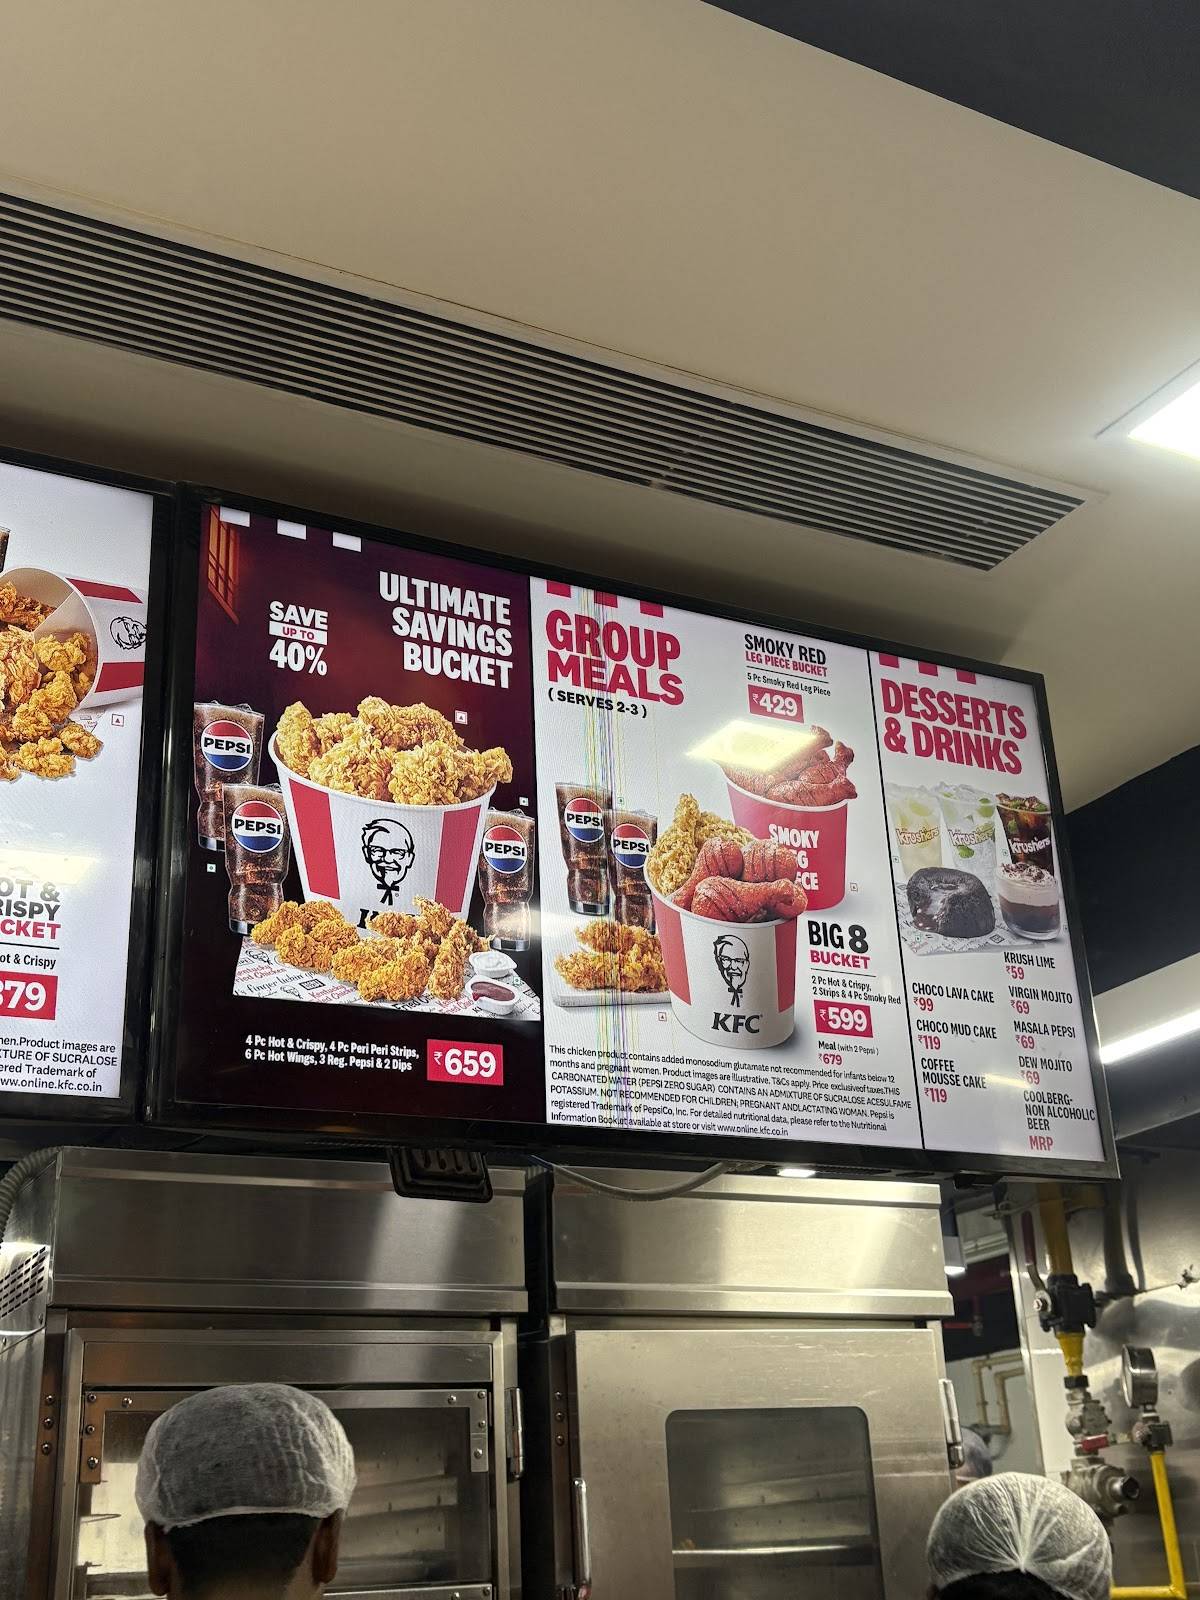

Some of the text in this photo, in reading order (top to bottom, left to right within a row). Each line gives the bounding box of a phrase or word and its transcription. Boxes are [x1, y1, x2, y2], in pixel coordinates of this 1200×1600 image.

[380, 571, 511, 625] ULTIMATE
[270, 601, 328, 630] SAVE
[282, 626, 314, 641] UP TO
[392, 608, 512, 656] SAVINGS
[546, 610, 680, 671] GROUP
[270, 639, 328, 676] 40%
[744, 634, 826, 665] SMOKY RED
[403, 641, 512, 689] BUCKET
[745, 651, 828, 677] LEG PIECE BUCKET
[548, 650, 684, 706] MEALS
[747, 672, 831, 696] 5 Pc Smoky Red Leg Piece
[752, 692, 798, 717] ₹429
[881, 678, 1027, 739] DESSERTS
[204, 737, 250, 754] PEPSI
[884, 716, 1022, 775] & DRINKS
[234, 819, 281, 835] PEPSI
[768, 824, 819, 848] SMOKY
[485, 842, 524, 857] PEPSI
[40, 882, 60, 902] &
[0, 919, 61, 939] CKET
[808, 920, 844, 949] BIG
[849, 924, 869, 953] 8
[24, 955, 56, 970] Crispy
[810, 950, 870, 969] BUCKET
[1004, 952, 1055, 969] KRUSH LIME
[1006, 966, 1024, 980] ₹59
[812, 976, 871, 991] 2 Pc Hot & Crispy,
[912, 982, 994, 1003] CHOCO LAVA CAKE
[0, 981, 46, 1011] 79
[812, 986, 817, 995] 2
[818, 987, 839, 998] Strips
[841, 990, 847, 998] &
[848, 991, 852, 999] 4
[854, 991, 862, 1000] Pc
[864, 993, 886, 1004] Smoky
[913, 997, 934, 1012] ₹99
[1008, 985, 1072, 1004] VIRGIN MOJITO
[1010, 1000, 1030, 1014] ₹69
[711, 1011, 761, 1034] KFC
[820, 1006, 867, 1032] ₹599
[916, 1019, 997, 1039] CHOCO MUD CAKE
[1014, 1020, 1076, 1038] MASALA PEPSI
[62, 1040, 116, 1053] images are
[245, 1035, 419, 1059] 4 Pc Hot & Crispy, 4 Pc Peri Peri Strips,
[818, 1041, 836, 1050] Meal
[918, 1035, 941, 1050] ₹119
[1016, 1035, 1035, 1049] ₹69
[35, 1051, 117, 1066] OF SUCRALOSE
[244, 1049, 412, 1072] 6 Pc Hot Wings, 3 Reg. Pepsi & 2 Dips
[433, 1048, 496, 1077] ₹659
[550, 1045, 866, 1081] This chicken contains added monosodium glutamate recommended infants
[921, 1057, 955, 1073] COFFEE
[1018, 1056, 1072, 1072] DEW MOJITO
[25, 1064, 97, 1078] Trademark of
[632, 1066, 828, 1089] women. Product illustrative. Price
[922, 1072, 987, 1089] MOUSSE CAKE
[550, 1085, 780, 1110] POTASSIUM. CHILDREN; PREGNANT
[552, 1072, 912, 1108] CARBONATED SUGAR) CONTAINS ADMIXTURE SUCRALOSE ACESULFAME
[924, 1087, 948, 1103] ₹119
[1023, 1090, 1073, 1106] COOLBERG-
[551, 1099, 887, 1131] registered PepsiCo, nutritional please Nutritional
[552, 1112, 596, 1123] Information
[629, 1118, 661, 1127] available
[1025, 1104, 1096, 1121] NON ALCOHOLIC
[1027, 1118, 1050, 1131] BEER
[1029, 1135, 1053, 1150] MRP
